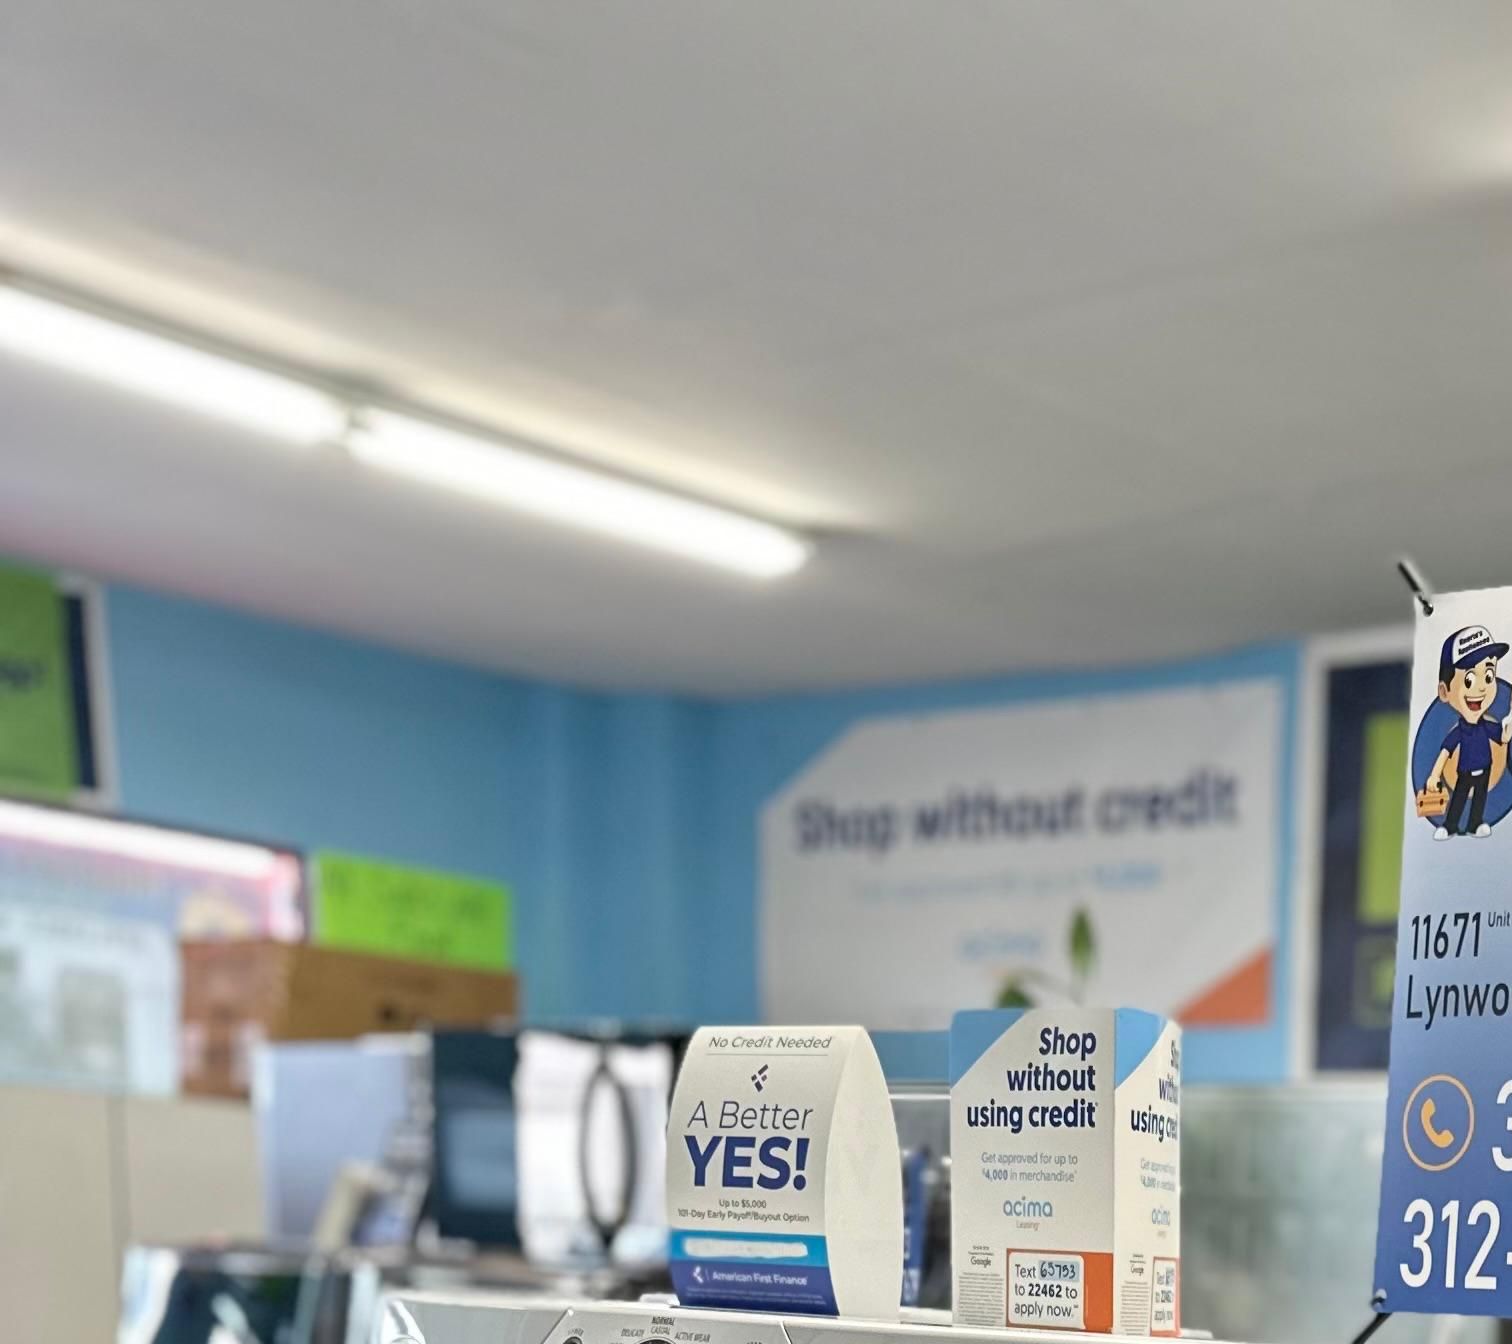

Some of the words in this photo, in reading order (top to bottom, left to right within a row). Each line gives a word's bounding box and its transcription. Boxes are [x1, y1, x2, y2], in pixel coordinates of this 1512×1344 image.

[796, 797, 896, 858] Shop
[914, 783, 1085, 846] without
[1096, 766, 1241, 833] credit
[1411, 911, 1481, 960] 11671
[1487, 910, 1511, 928] Unit
[709, 1036, 728, 1048] No
[732, 1035, 772, 1048] Credit
[776, 1036, 832, 1049] Needed
[1039, 1026, 1097, 1061] Shop
[1007, 1062, 1096, 1092] without
[687, 1100, 708, 1129] A
[719, 1101, 813, 1131] Better
[966, 1098, 1023, 1134] using
[1131, 1104, 1164, 1142] using
[684, 1135, 810, 1191] YES!
[981, 1152, 996, 1164] Get
[998, 1152, 1038, 1166] approved
[1040, 1152, 1052, 1165] for
[1054, 1155, 1066, 1166] up
[1068, 1154, 1078, 1165] to
[1010, 1168, 1018, 1181] in
[718, 1199, 730, 1209] Up
[731, 1199, 740, 1208] to
[1002, 1195, 1053, 1218] acima
[707, 1210, 726, 1220] Early
[783, 1212, 810, 1224] Option
[712, 1271, 751, 1282] American
[753, 1272, 773, 1284] First
[773, 1274, 808, 1286] Finance
[1014, 1263, 1036, 1279] Text
[1014, 1283, 1026, 1296] to
[1028, 1283, 1063, 1299] 22462
[1065, 1285, 1078, 1300] to
[1014, 1301, 1044, 1318] apply
